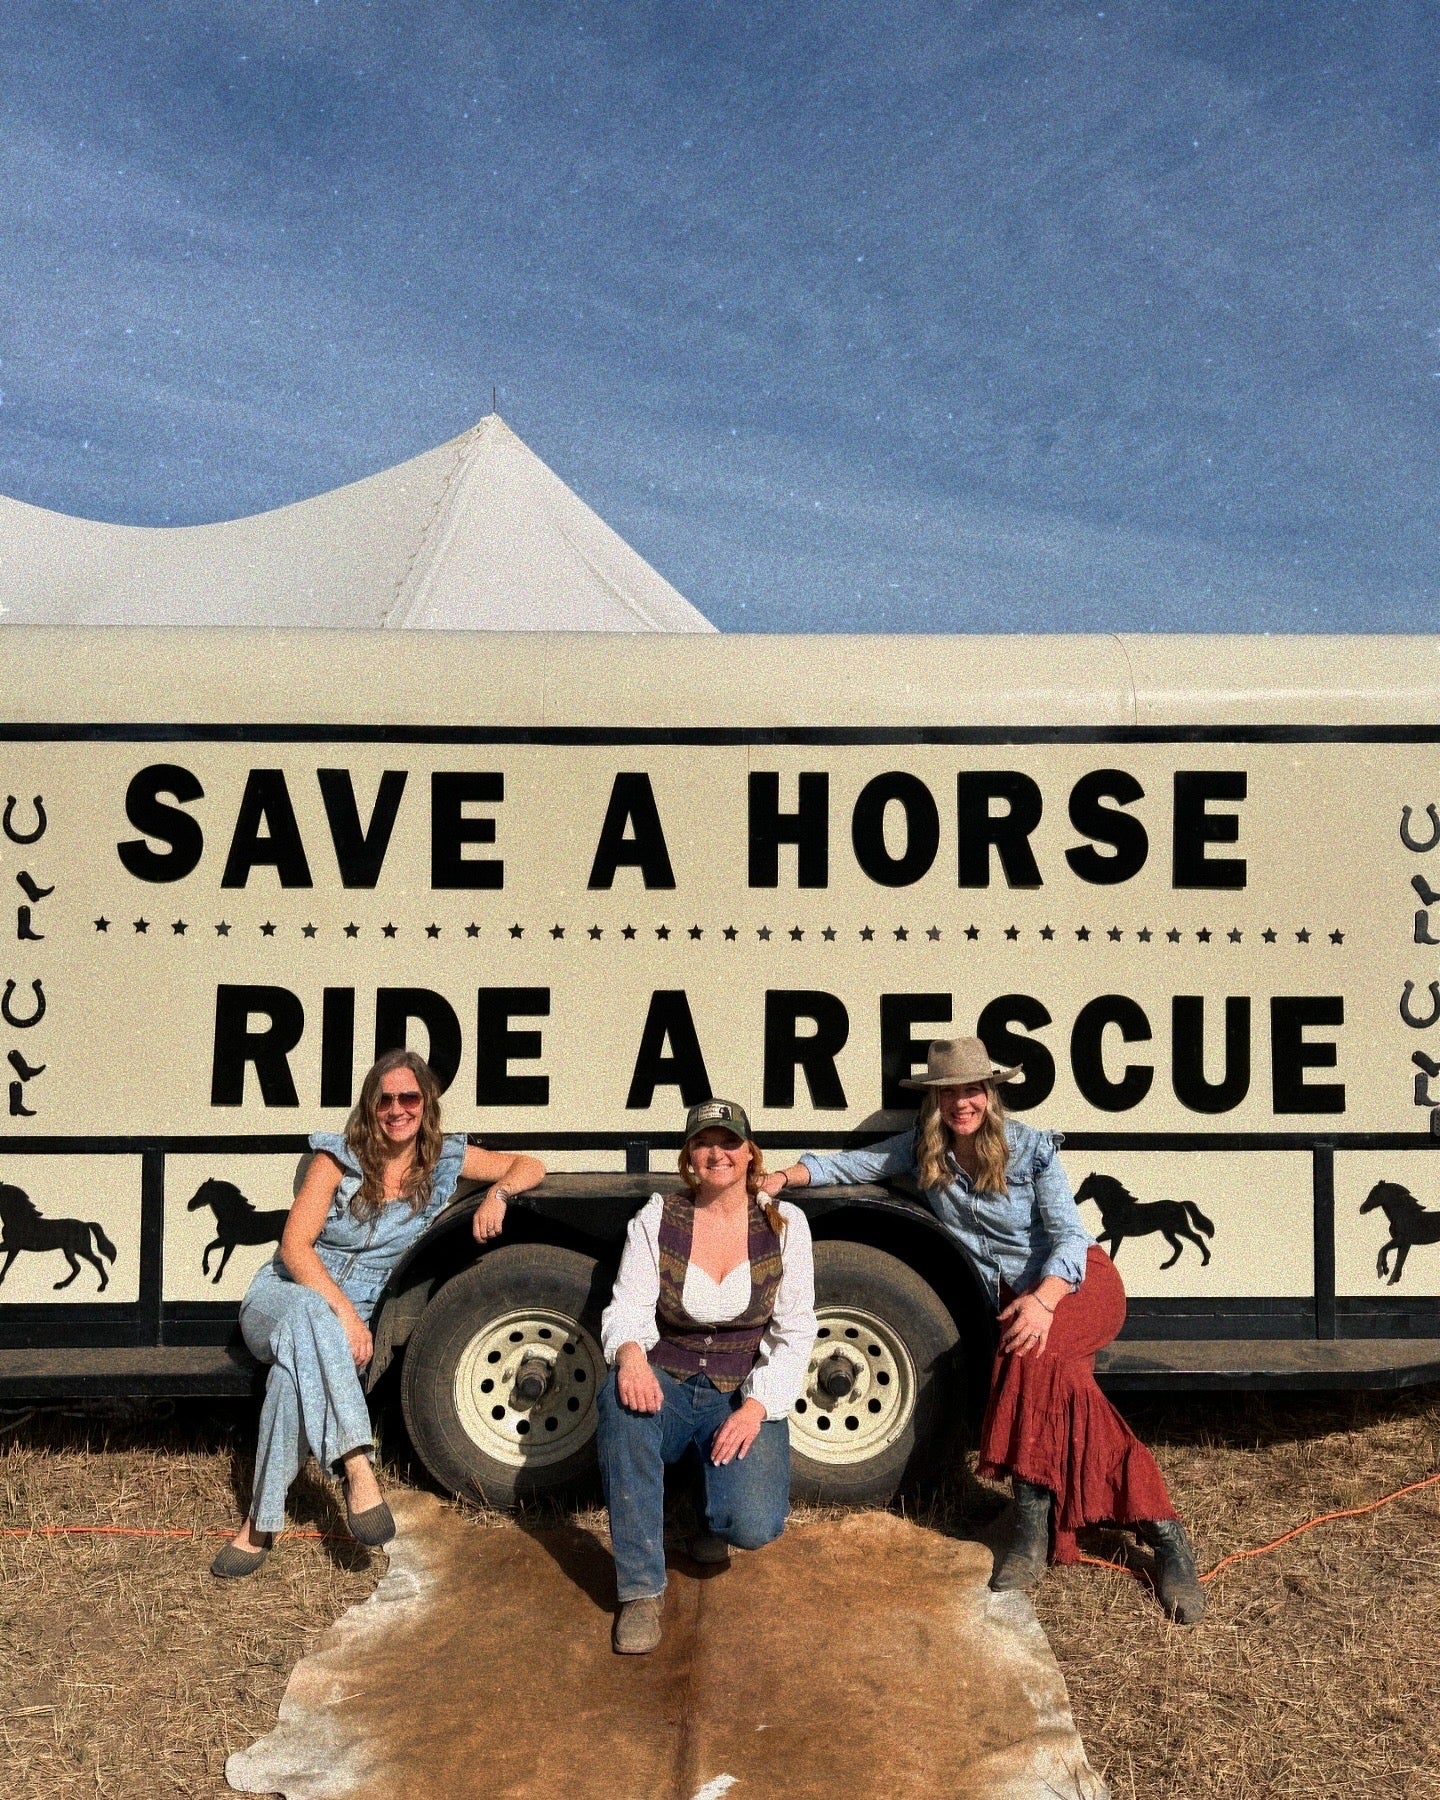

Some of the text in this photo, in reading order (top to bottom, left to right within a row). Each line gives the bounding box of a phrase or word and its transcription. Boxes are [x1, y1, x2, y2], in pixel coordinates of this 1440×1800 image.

[117, 763, 1247, 890] SAVE A HORSE
[211, 984, 1346, 1114] RIDE A RESCUE
